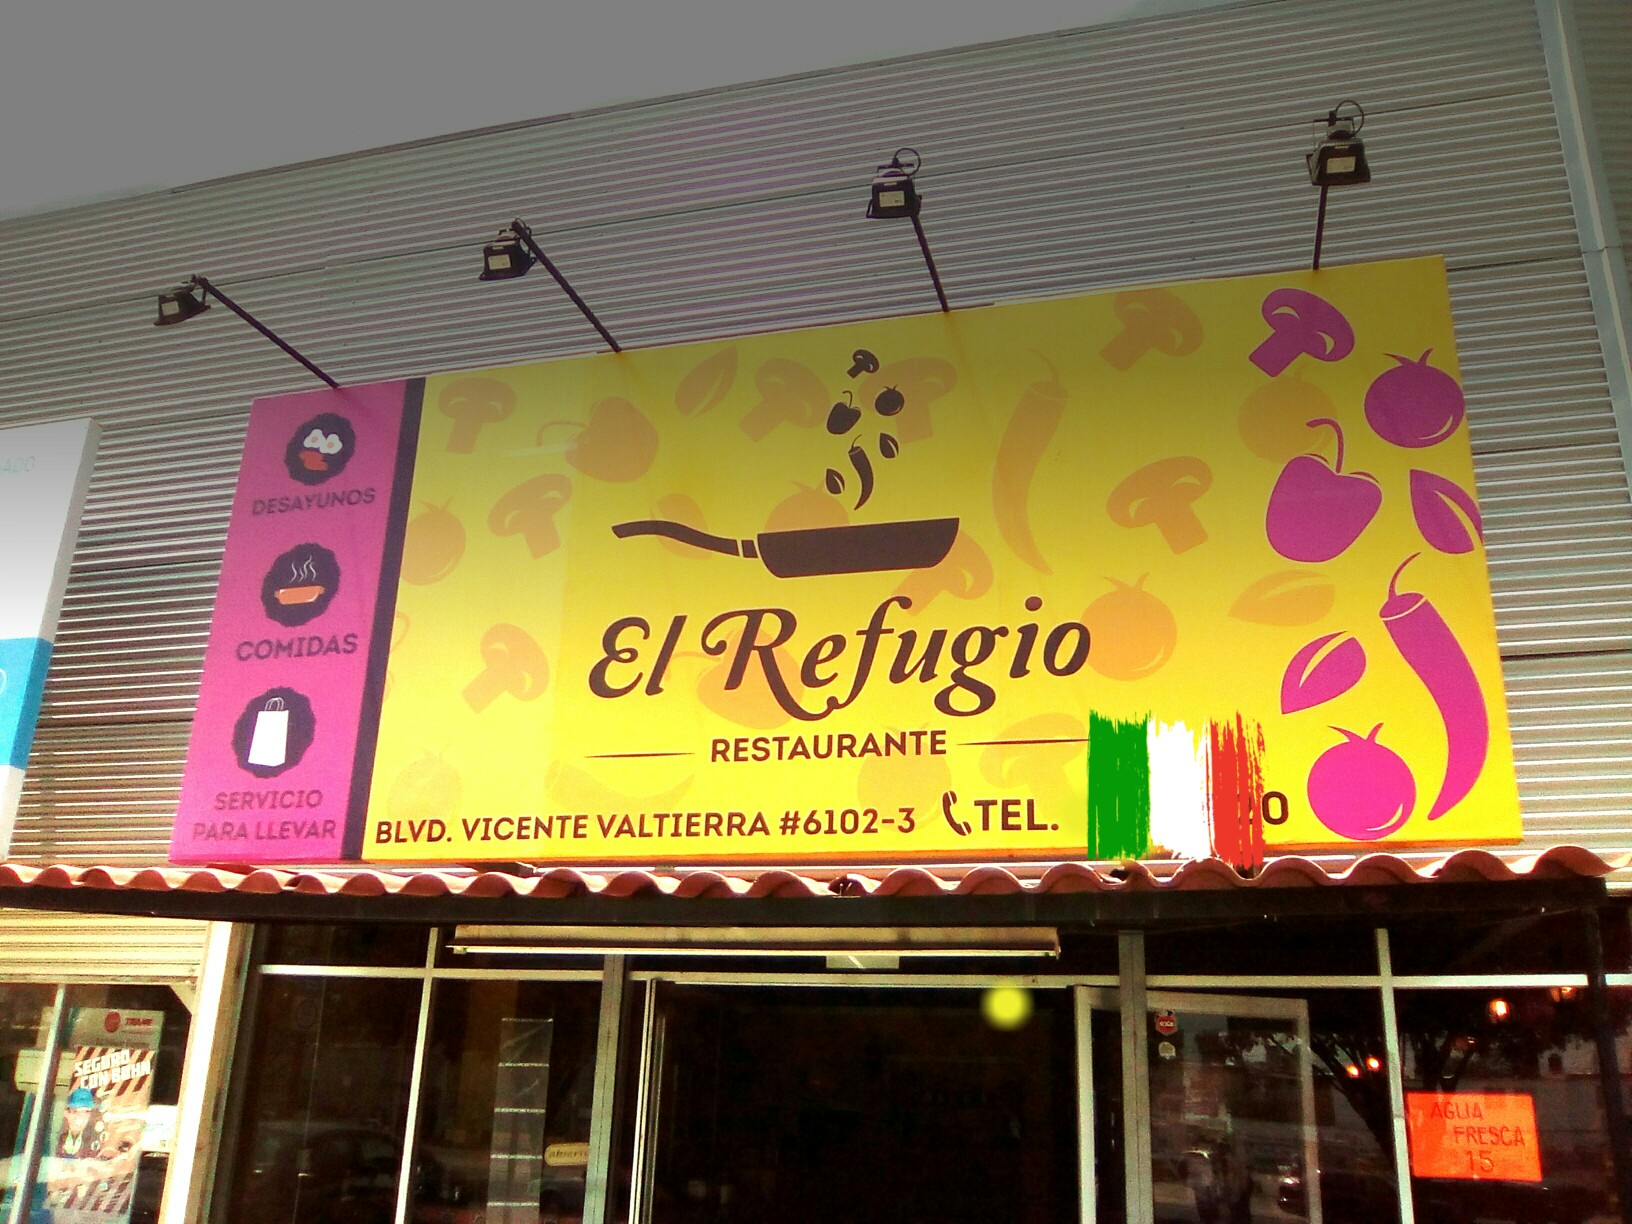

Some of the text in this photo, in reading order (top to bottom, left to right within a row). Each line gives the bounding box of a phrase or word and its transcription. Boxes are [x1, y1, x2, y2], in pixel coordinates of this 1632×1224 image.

[252, 488, 376, 515] DESAYUNOS
[236, 633, 359, 662] COMIDAS
[588, 596, 1091, 722] El Refugio
[710, 730, 947, 763] RESTAURANTE
[214, 790, 323, 811] SERVICIO
[375, 807, 915, 844] BLVD. VICENTE VALTIERRA #6102-3
[974, 798, 1059, 832] TEL.
[192, 820, 336, 841] PARA LLEVAR
[74, 1049, 131, 1077] SEGURO
[80, 1070, 109, 1090] CON
[1430, 1101, 1485, 1121] AGUA
[1453, 1125, 1526, 1147] FRESCA
[1464, 1149, 1494, 1173] 15
